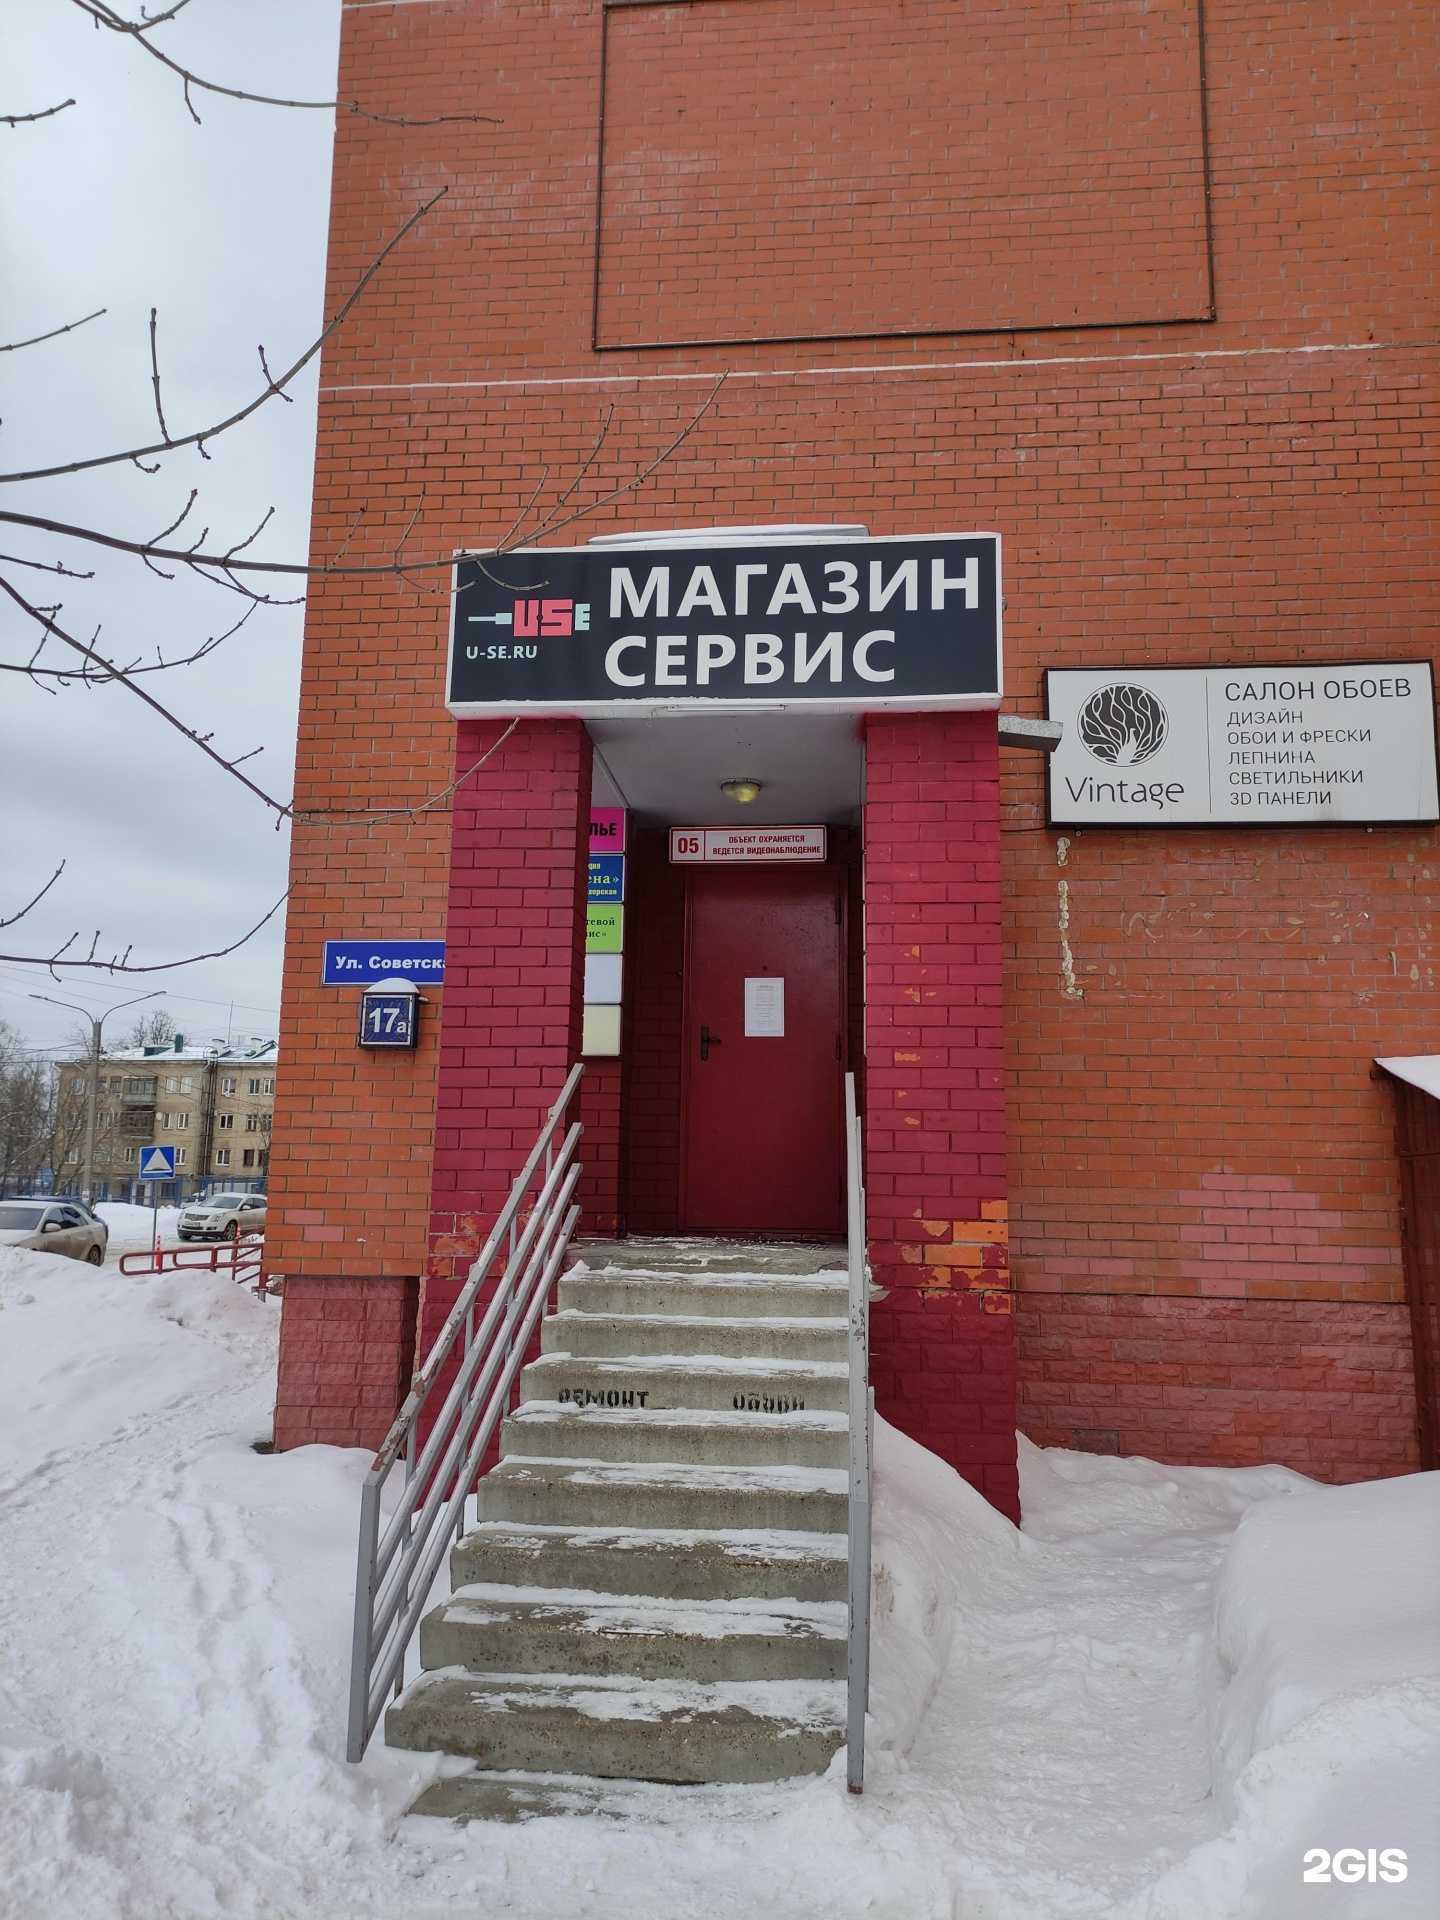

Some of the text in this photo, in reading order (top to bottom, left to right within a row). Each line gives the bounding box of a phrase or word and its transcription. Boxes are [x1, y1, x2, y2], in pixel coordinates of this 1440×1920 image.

[609, 557, 980, 619] МАГАЗИН
[466, 645, 538, 660] U-SE.RU
[605, 630, 896, 688] СЕРВИС
[1225, 678, 1412, 701] САЛОН ОБОЕВ
[1227, 708, 1304, 727] ДИЗАЙН
[1227, 729, 1371, 745] ОБОИ И ФРЕСКИ
[1228, 751, 1316, 765] ЛЕПНИНА
[1229, 769, 1364, 785] СВЕТИЛЬНИКИ
[1065, 776, 1186, 810] Vintage
[1230, 791, 1332, 806] 3D ПАНЕЛИ
[677, 837, 699, 854] 05
[729, 834, 805, 844] ОБЪЕКТ ОХРАНЯЕТСЯ
[712, 845, 821, 856] ВЕДЕТСЯ ВИДЕОНАБЛЮДЕНИЕ
[335, 956, 363, 970] Ул.
[369, 1007, 407, 1033] 17а
